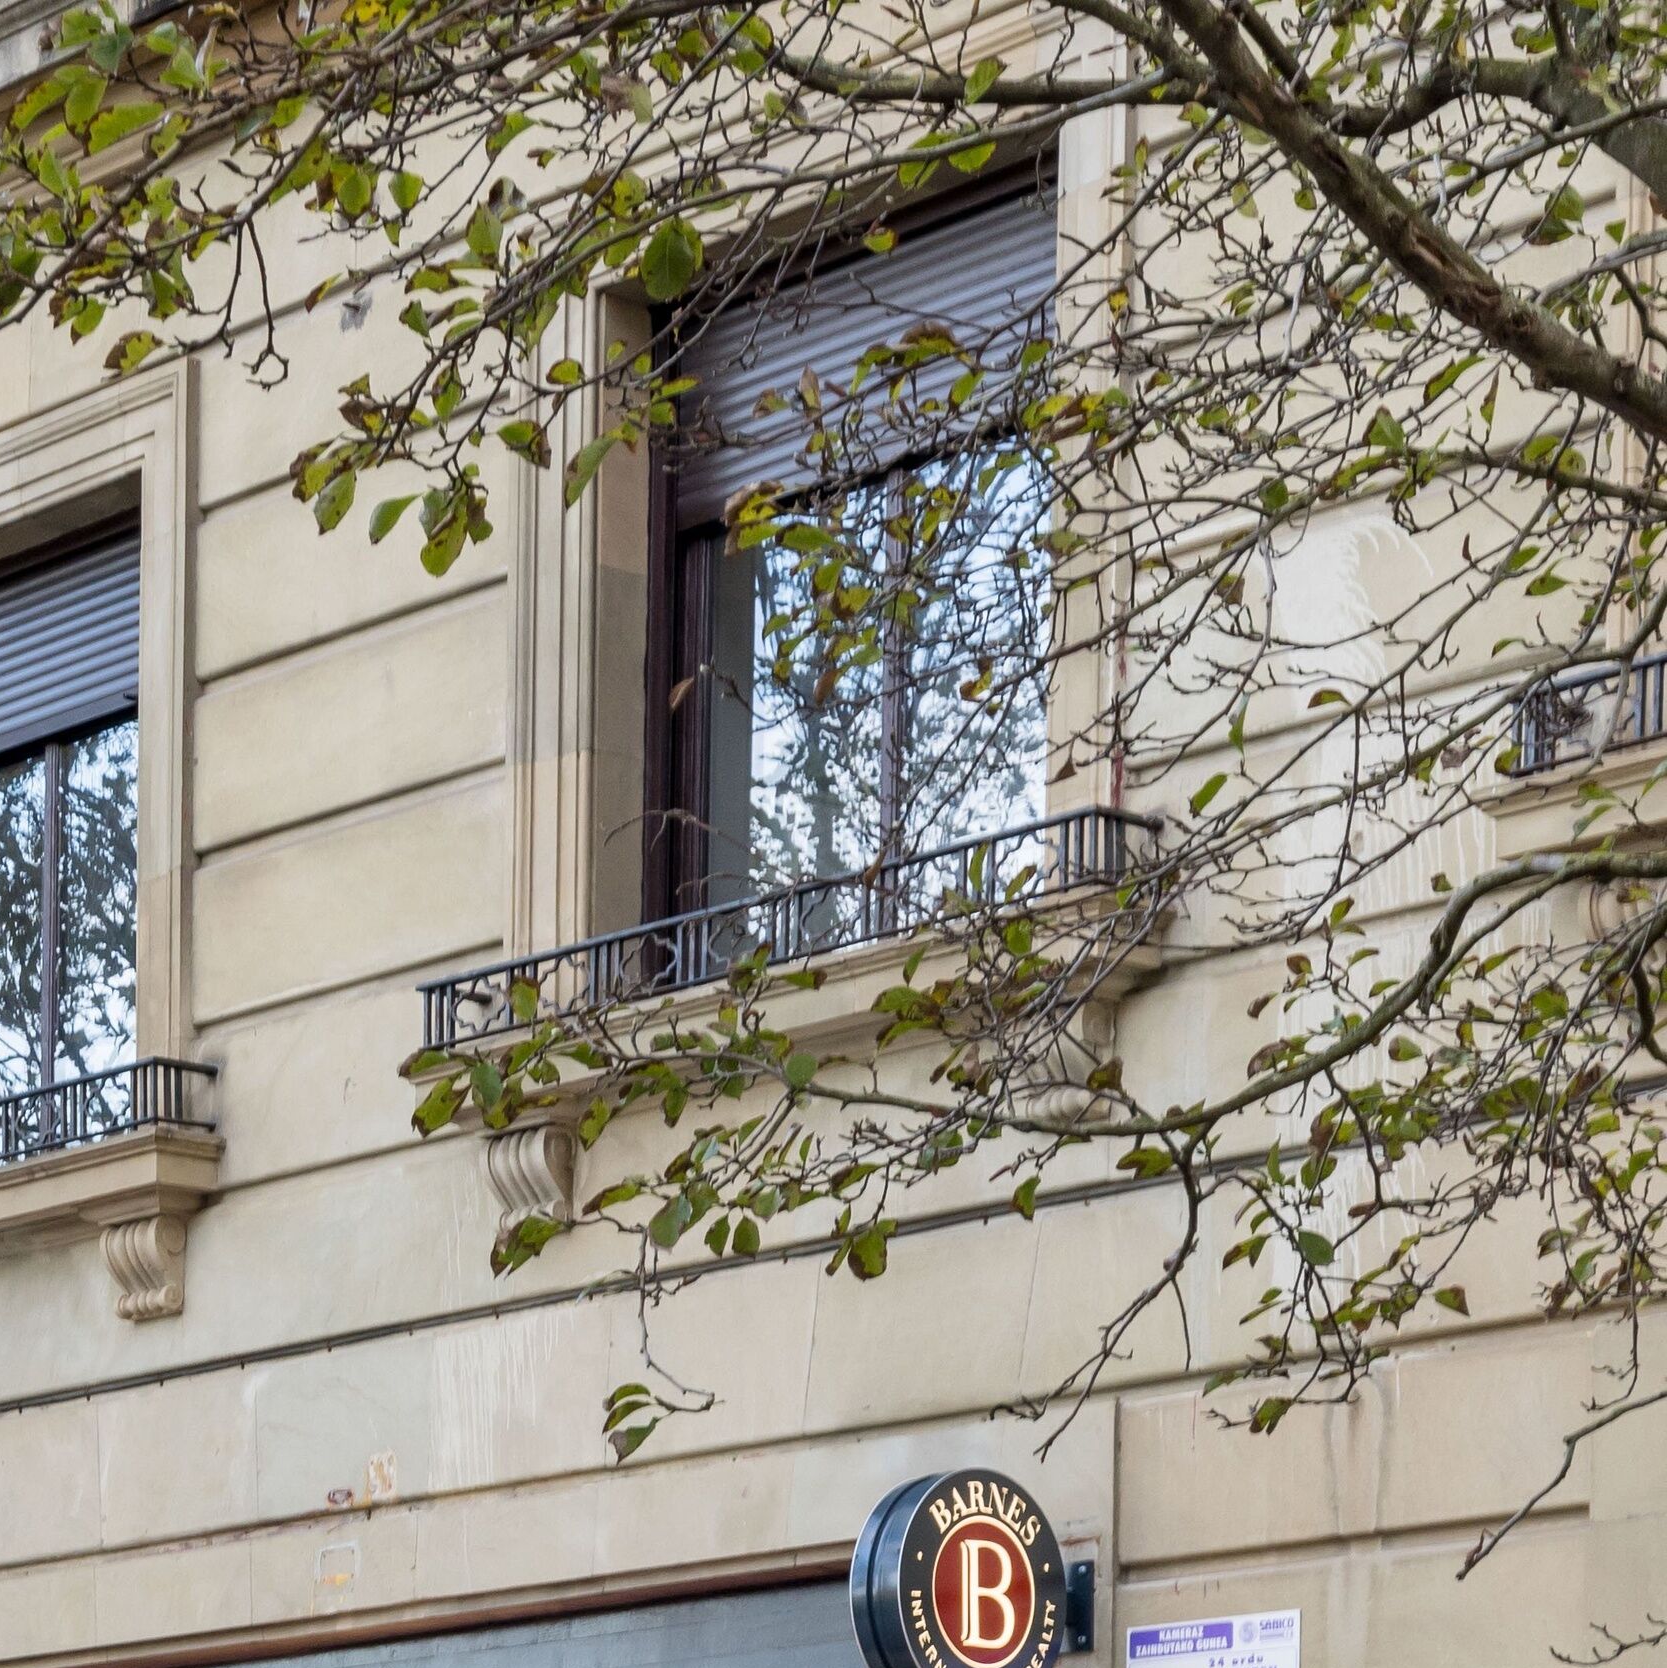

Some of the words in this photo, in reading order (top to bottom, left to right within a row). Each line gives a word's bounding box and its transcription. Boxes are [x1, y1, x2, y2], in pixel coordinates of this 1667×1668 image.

[929, 1480, 1041, 1546] BARNES
[960, 1539, 1016, 1649] B
[1209, 1657, 1225, 1668] 24
[1232, 1653, 1264, 1665] ordu
